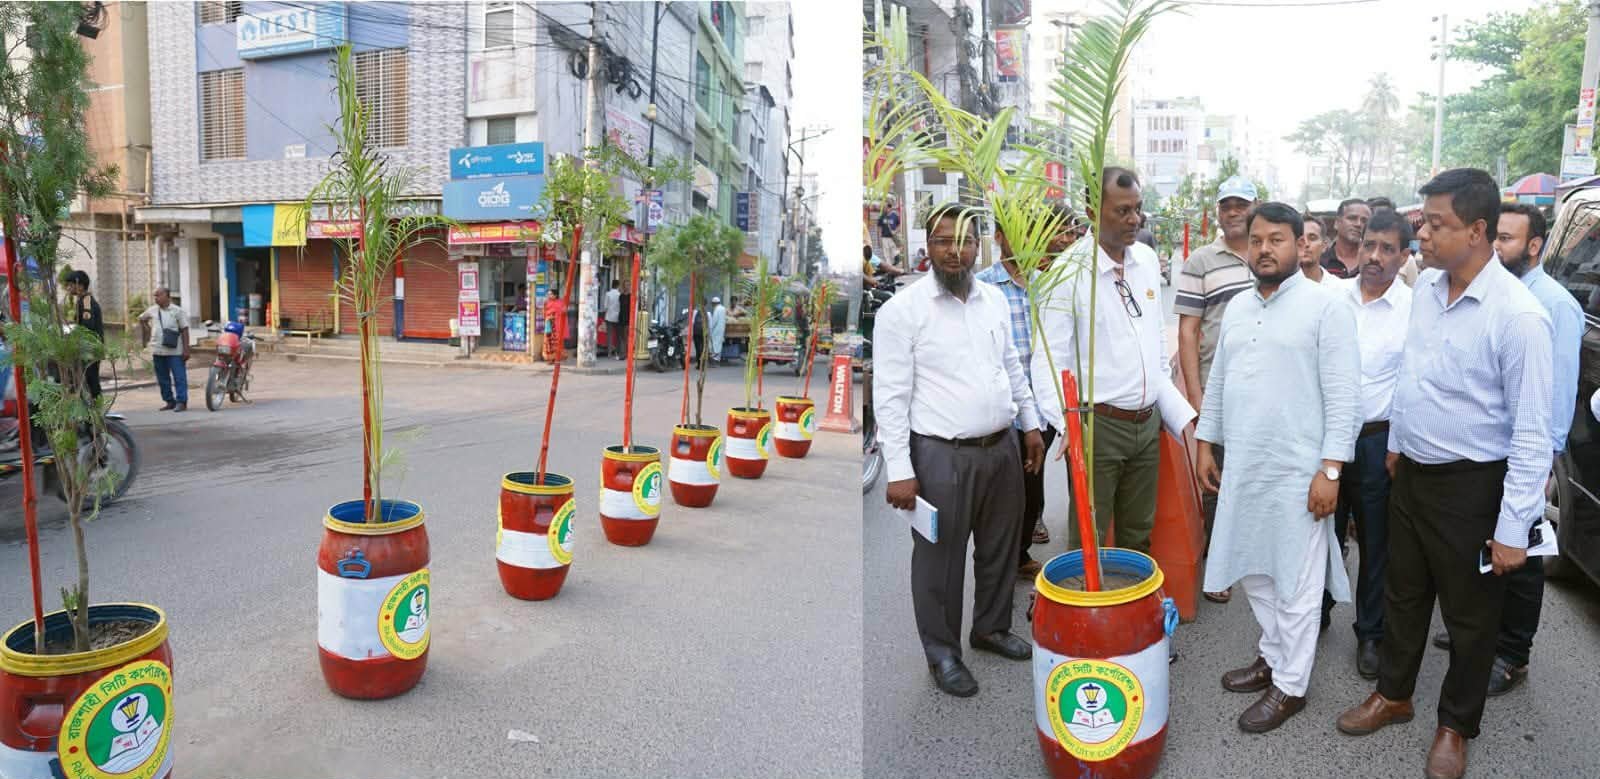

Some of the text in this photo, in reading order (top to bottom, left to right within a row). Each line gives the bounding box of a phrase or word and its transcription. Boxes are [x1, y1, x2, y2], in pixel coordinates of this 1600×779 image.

[259, 10, 310, 35] NEST
[833, 365, 846, 414] WALTON
[100, 675, 128, 696] সিটি
